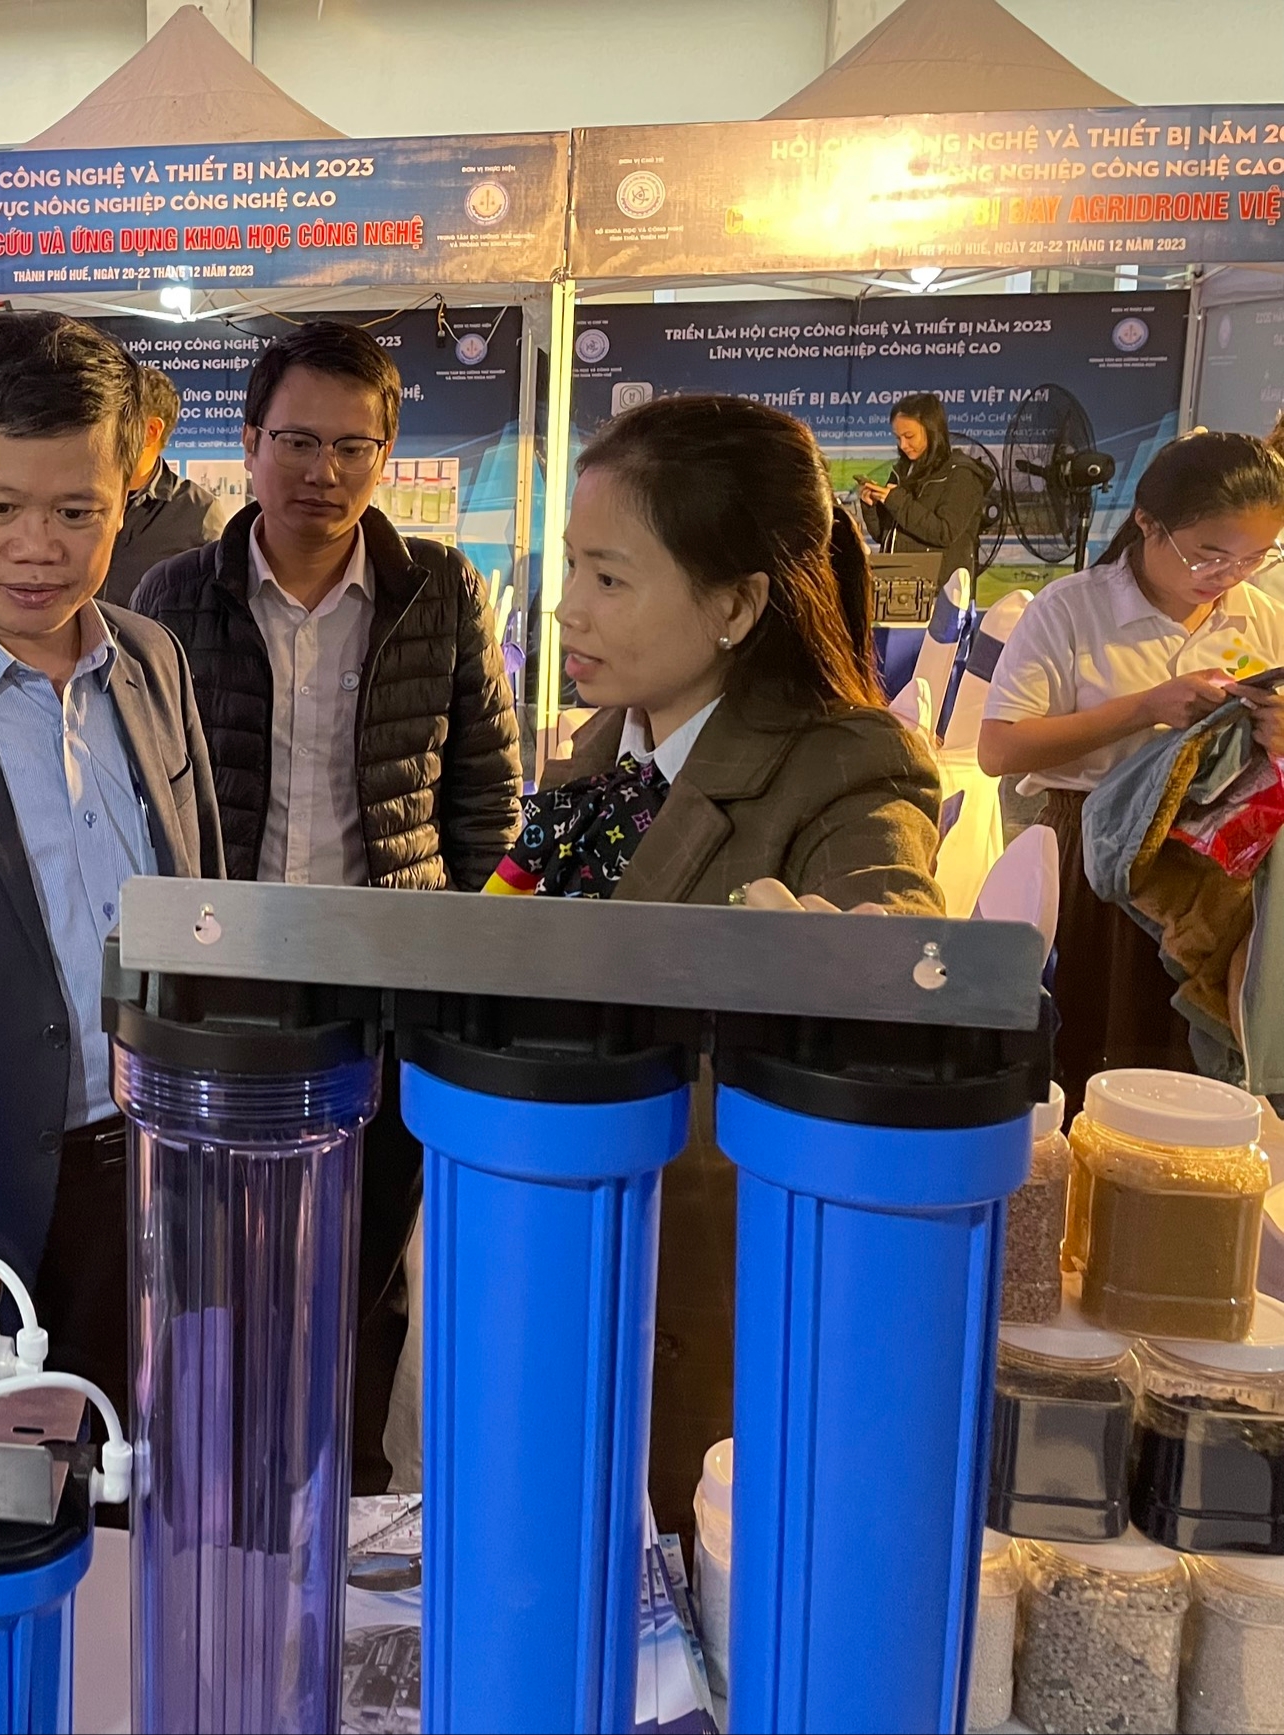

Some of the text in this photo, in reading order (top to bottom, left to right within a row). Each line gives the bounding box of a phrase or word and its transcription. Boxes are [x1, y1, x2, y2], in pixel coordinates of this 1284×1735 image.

[967, 124, 1039, 154] NGHỆ
[1046, 123, 1080, 149] VÀ
[1087, 118, 1161, 147] THIẾT
[1167, 126, 1191, 151] BỊ
[1198, 120, 1257, 146] NĂM
[66, 163, 125, 189] NGHỆ
[131, 161, 159, 183] VÀ
[165, 154, 228, 182] THIẾT
[232, 160, 254, 185] BỊ
[260, 157, 309, 178] NĂM
[316, 157, 375, 178] 2023
[1000, 158, 1086, 184] NGHIỆP
[1091, 157, 1159, 178] CÔNG
[1165, 153, 1230, 181] NGHỆ
[1235, 157, 1284, 176] CAO
[34, 195, 89, 216] NÔNG
[94, 191, 164, 216] NGHIỆP
[169, 190, 228, 211] CÔNG
[233, 187, 288, 212] NGHỆ
[292, 190, 336, 207] CAO
[1008, 195, 1062, 224] BAY
[1067, 191, 1230, 223] AGRIDRONE
[1239, 184, 1284, 226] VIỆ
[38, 227, 66, 255] VÀ
[70, 226, 114, 253] ỨNG
[119, 228, 178, 259] DỤNG
[183, 223, 241, 251] KHOA
[246, 223, 292, 254] HỌC
[297, 217, 358, 248] CÔNG
[363, 215, 423, 250] NGHỆ
[994, 238, 1026, 254] NGÀY
[1029, 240, 1063, 253] 20-22
[1066, 236, 1105, 252] THÁNG
[1109, 239, 1124, 252] 12
[1126, 236, 1154, 252] NĂM
[1156, 237, 1186, 251] 2023
[13, 263, 254, 283] THÀNH PHỐ HUẾ, NGÀY 20-22 THÁNG 12 NĂM 2023
[665, 317, 1051, 341] TRIỂN LÃM HỘI CHỢ CÔNG NGHỆ VÀ THIẾT BỊ NĂM 2023
[129, 338, 152, 354] HỘI
[154, 340, 182, 353] CHỢ
[184, 336, 221, 351] CÔNG
[224, 335, 259, 352] NGHỆ
[375, 335, 402, 347] 023
[709, 340, 1001, 362] LĨNH VỰC NÔNG NGHIỆP CÔNG NGHỆ CAO
[163, 356, 201, 370] NÔNG
[203, 356, 249, 372] NGHIỆP
[183, 387, 212, 402] ỨNG
[215, 390, 247, 404] DỤN
[764, 387, 805, 407] THIẾT
[809, 392, 825, 409] BỊ
[830, 391, 862, 405] BAY
[970, 385, 1005, 407] VIỆT
[1009, 388, 1049, 403] NAM
[177, 407, 244, 422] ỌC KHOA
